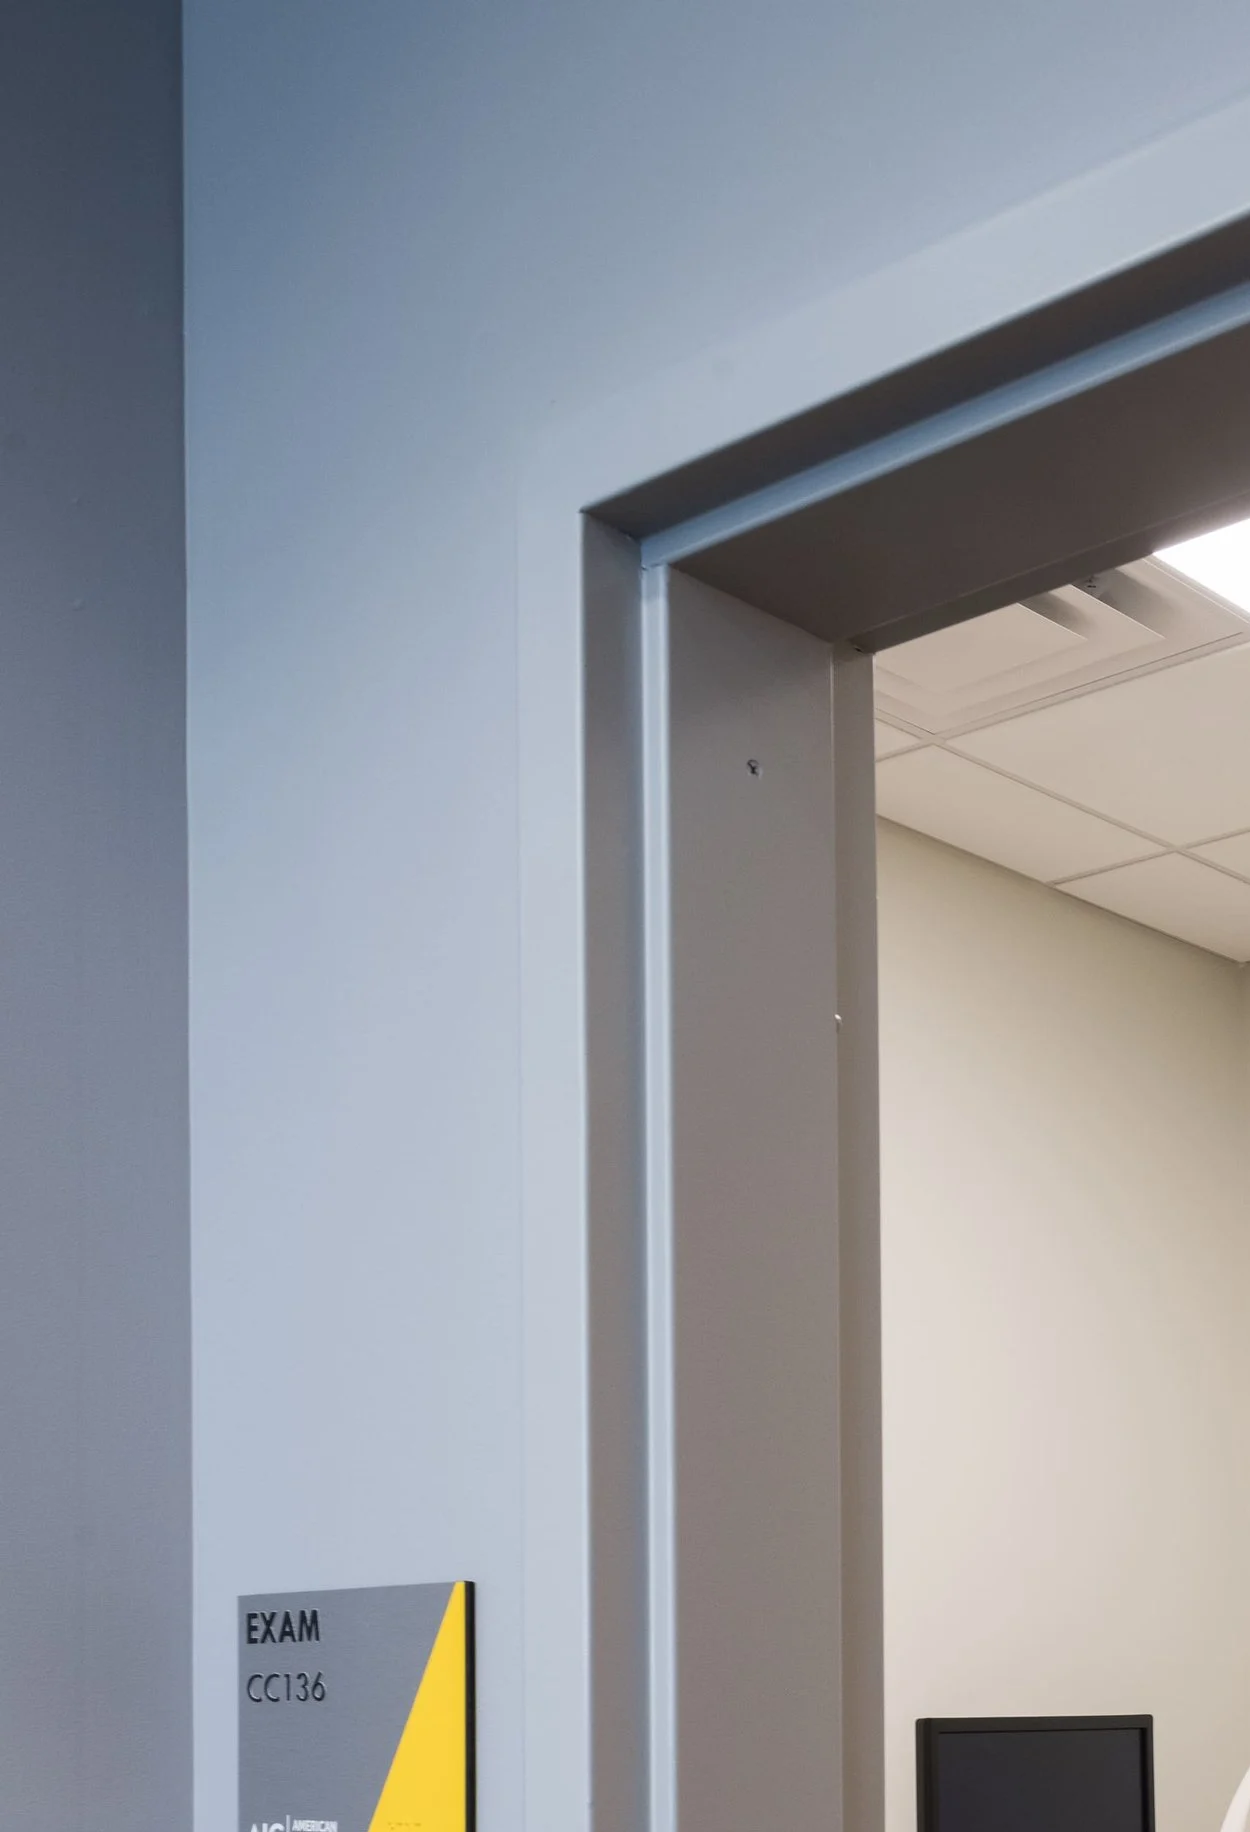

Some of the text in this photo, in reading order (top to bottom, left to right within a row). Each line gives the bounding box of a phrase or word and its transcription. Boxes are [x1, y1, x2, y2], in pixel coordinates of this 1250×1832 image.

[246, 1609, 320, 1644] EXAM
[247, 1672, 326, 1702] CC136
[292, 1819, 338, 1832] AMERICAN
